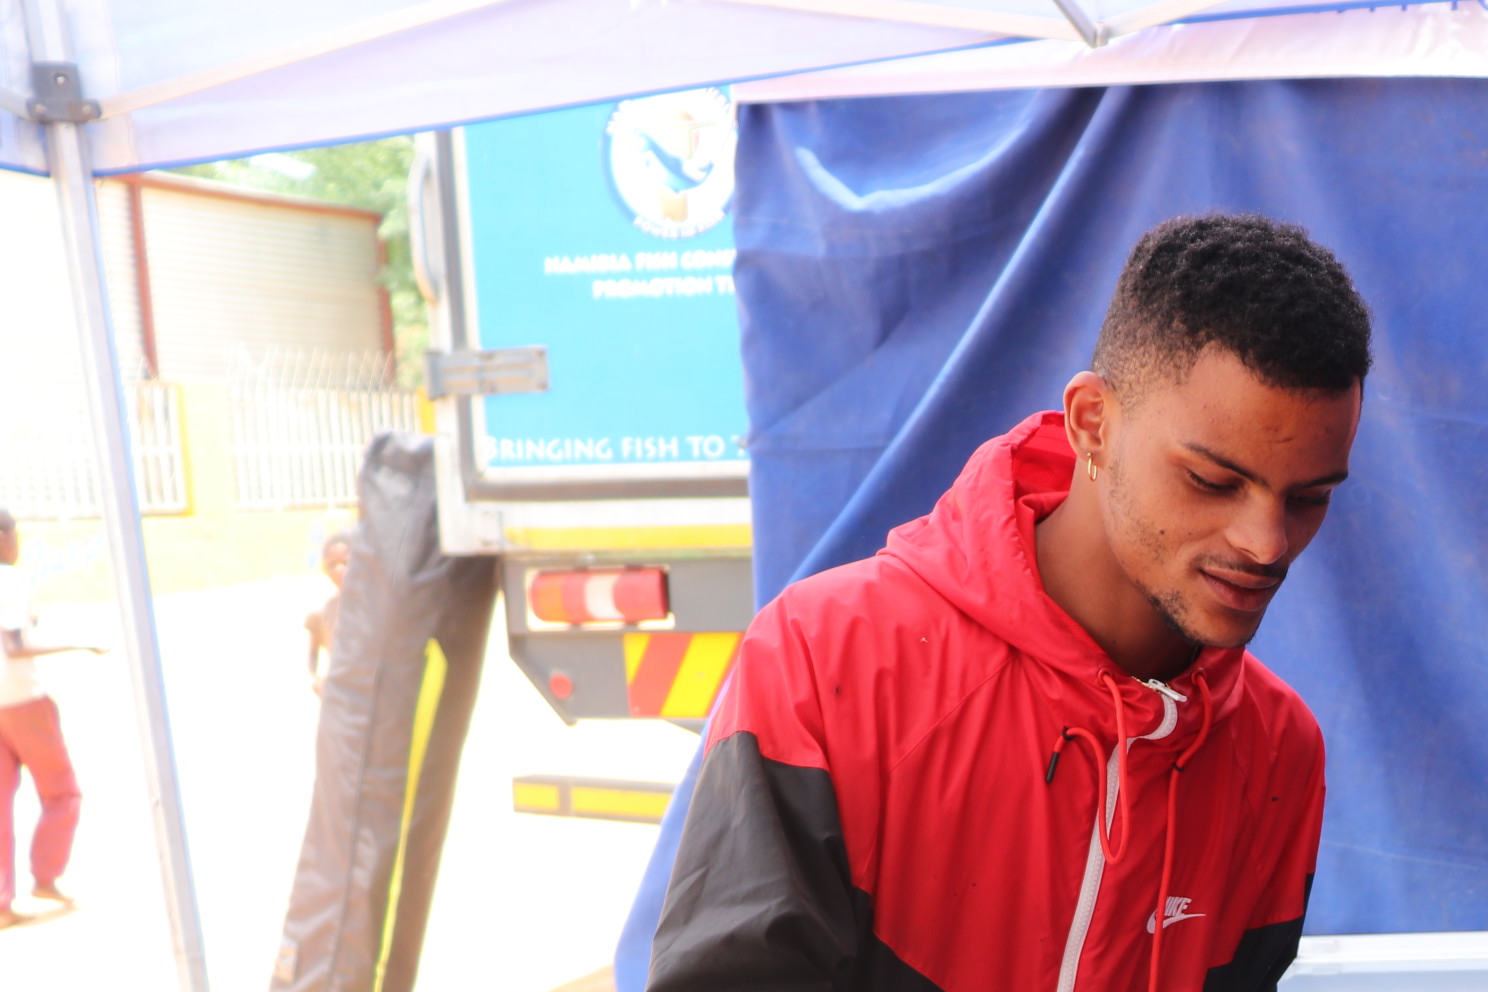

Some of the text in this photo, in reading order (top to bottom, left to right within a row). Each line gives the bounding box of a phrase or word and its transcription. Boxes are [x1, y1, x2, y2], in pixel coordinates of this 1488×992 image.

[544, 254, 632, 274] NAMIBIA
[635, 250, 678, 271] FISH
[592, 276, 713, 299] PROMOTION
[486, 436, 613, 461] BRINGING
[621, 436, 679, 459] FISH
[686, 434, 725, 458] TO
